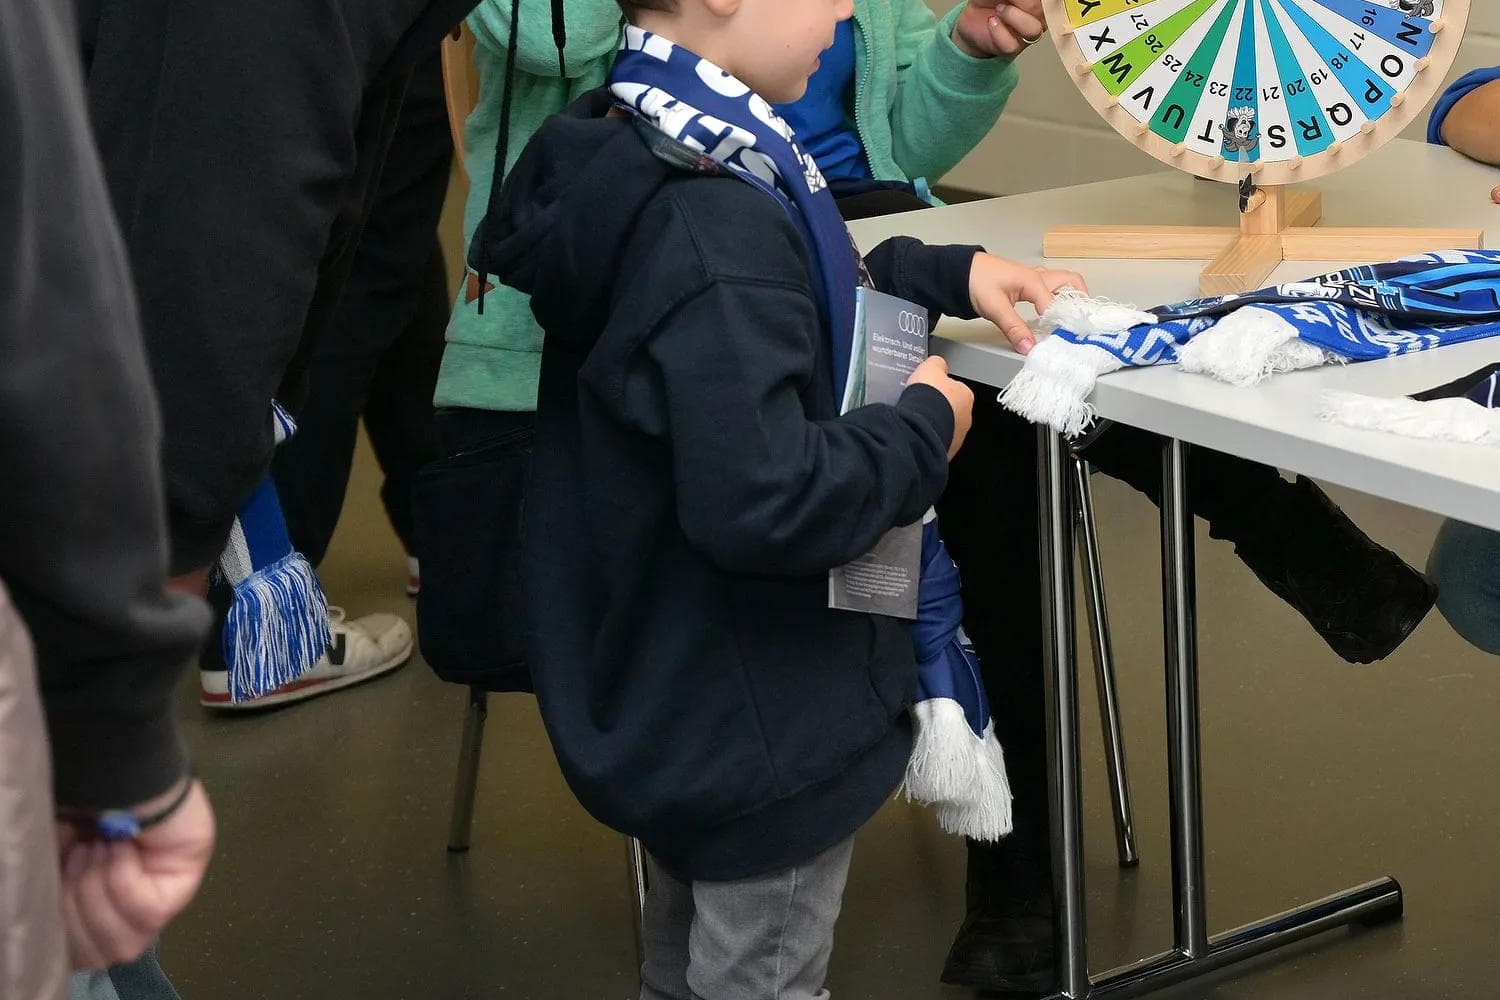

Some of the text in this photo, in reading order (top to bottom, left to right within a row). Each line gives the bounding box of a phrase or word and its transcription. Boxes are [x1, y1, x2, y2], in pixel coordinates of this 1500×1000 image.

[1130, 13, 1149, 30] 27
[1361, 9, 1375, 27] 16
[1090, 26, 1116, 51] X
[1349, 32, 1365, 50] 17
[1396, 22, 1422, 45] N
[1145, 34, 1164, 53] 26
[1102, 53, 1132, 84] W
[1162, 54, 1182, 72] 25
[1331, 52, 1348, 69] 18
[1381, 55, 1403, 77] O
[1185, 70, 1204, 86] 24
[1311, 69, 1328, 84] 19
[1209, 81, 1227, 96] 23
[1235, 87, 1253, 100] 22
[1262, 86, 1279, 100] 21
[1288, 78, 1305, 95] 20
[1365, 79, 1383, 103] P
[1132, 86, 1154, 110] V
[1162, 104, 1184, 129] U
[1326, 103, 1352, 126] Q
[1198, 120, 1214, 143] T
[1268, 125, 1286, 148] S
[1298, 116, 1322, 140] R
